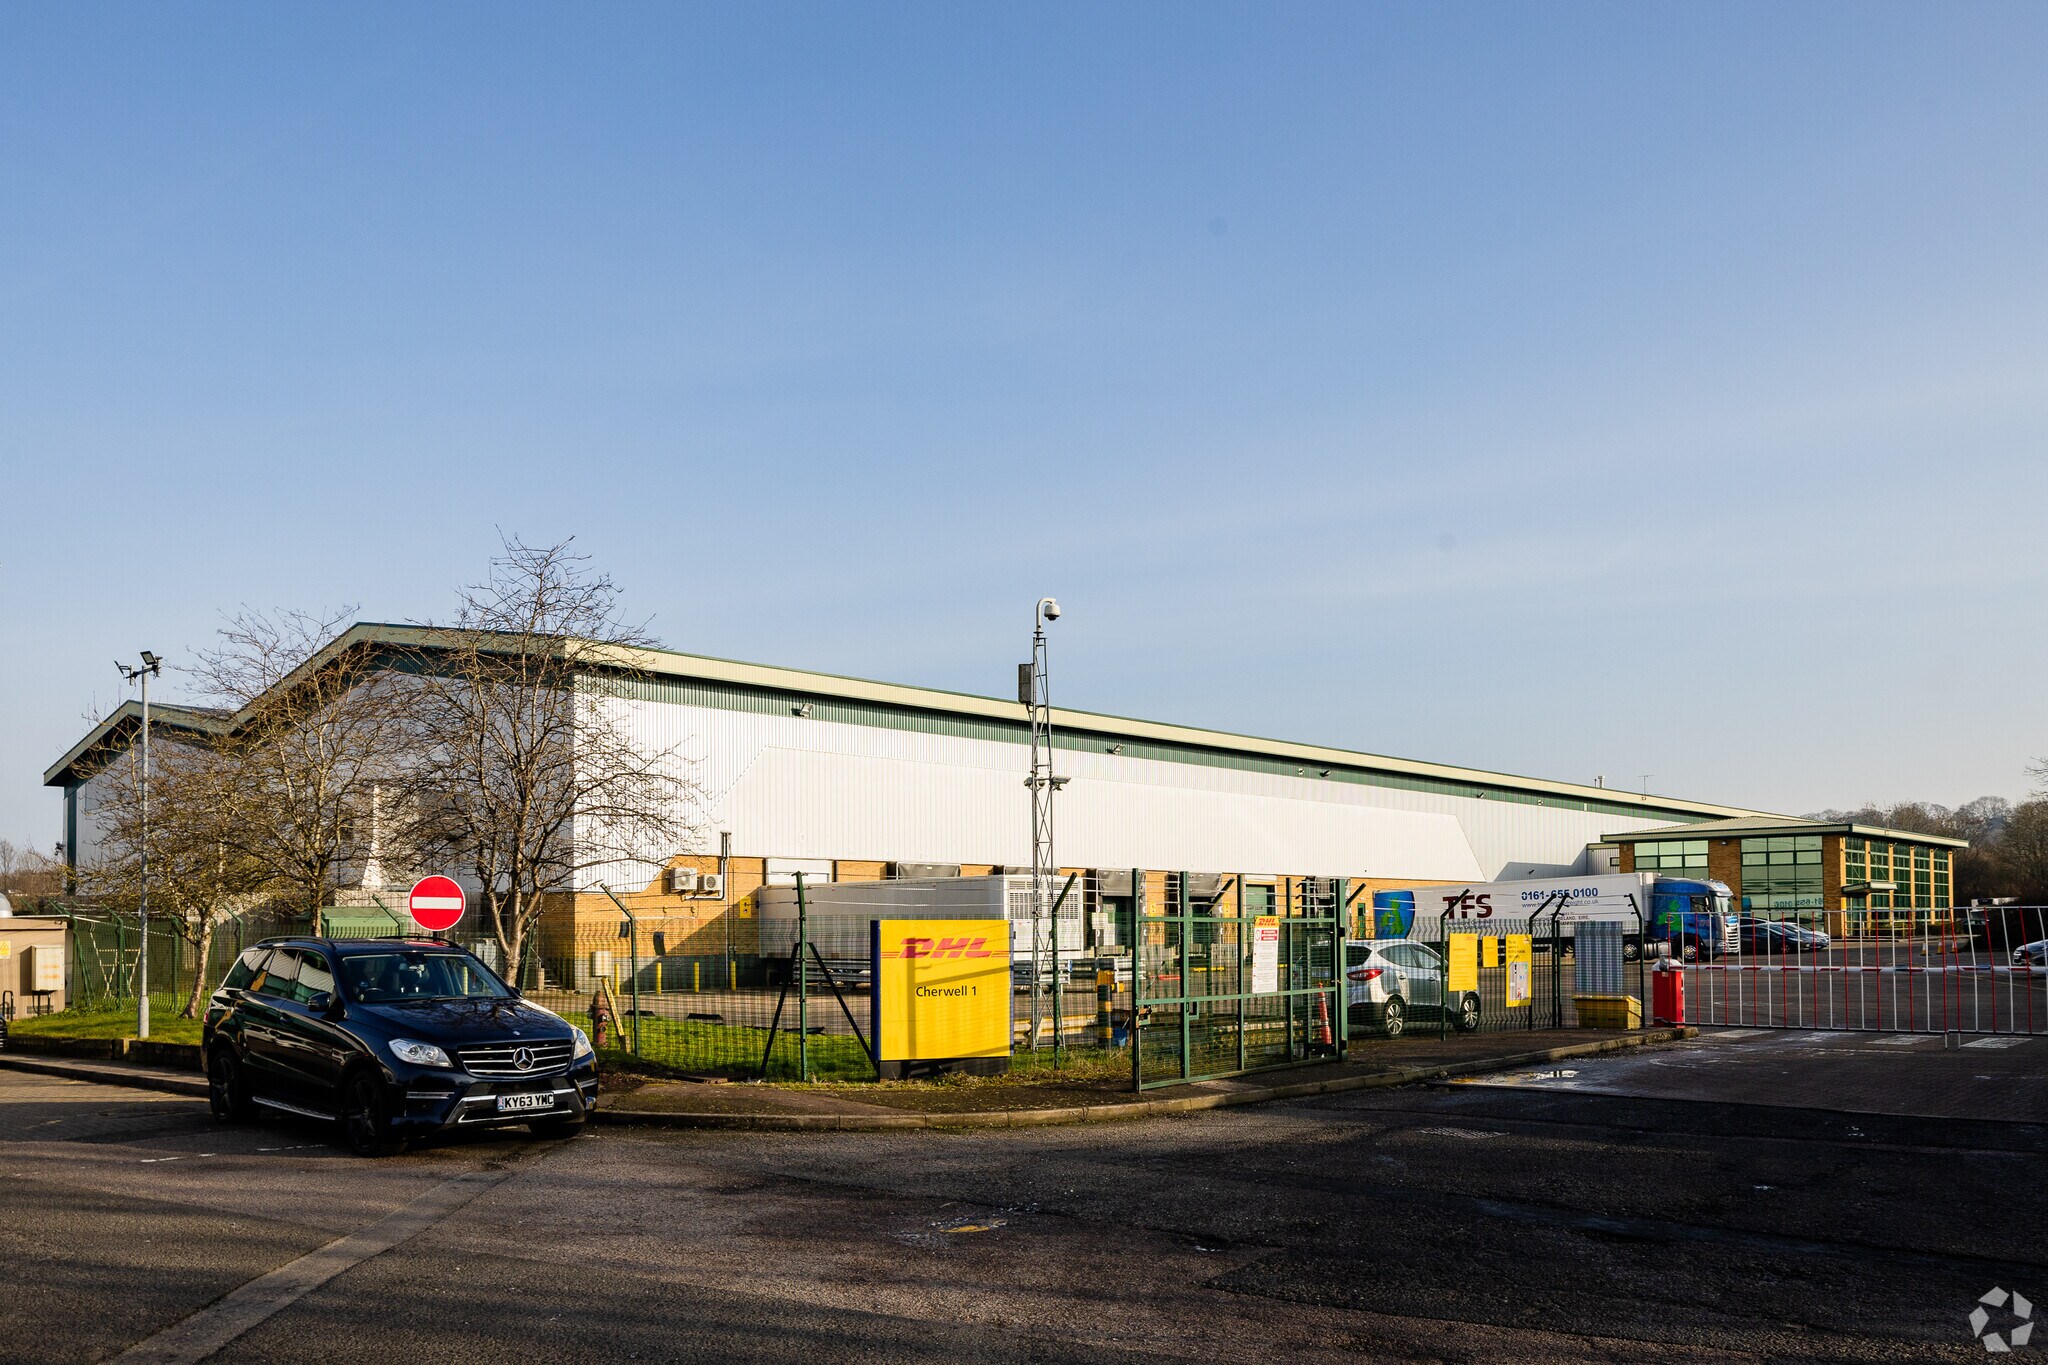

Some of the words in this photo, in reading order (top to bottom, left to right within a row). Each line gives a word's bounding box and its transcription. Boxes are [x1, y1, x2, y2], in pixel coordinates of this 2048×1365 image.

[1573, 887, 1598, 898] 0100
[1443, 894, 1493, 919] TFS
[1258, 918, 1276, 926] DHL
[899, 937, 992, 958] DHL
[916, 985, 967, 997] Cherwell
[972, 986, 977, 996] 1
[504, 1096, 533, 1108] KY63
[535, 1094, 553, 1105] YMC
